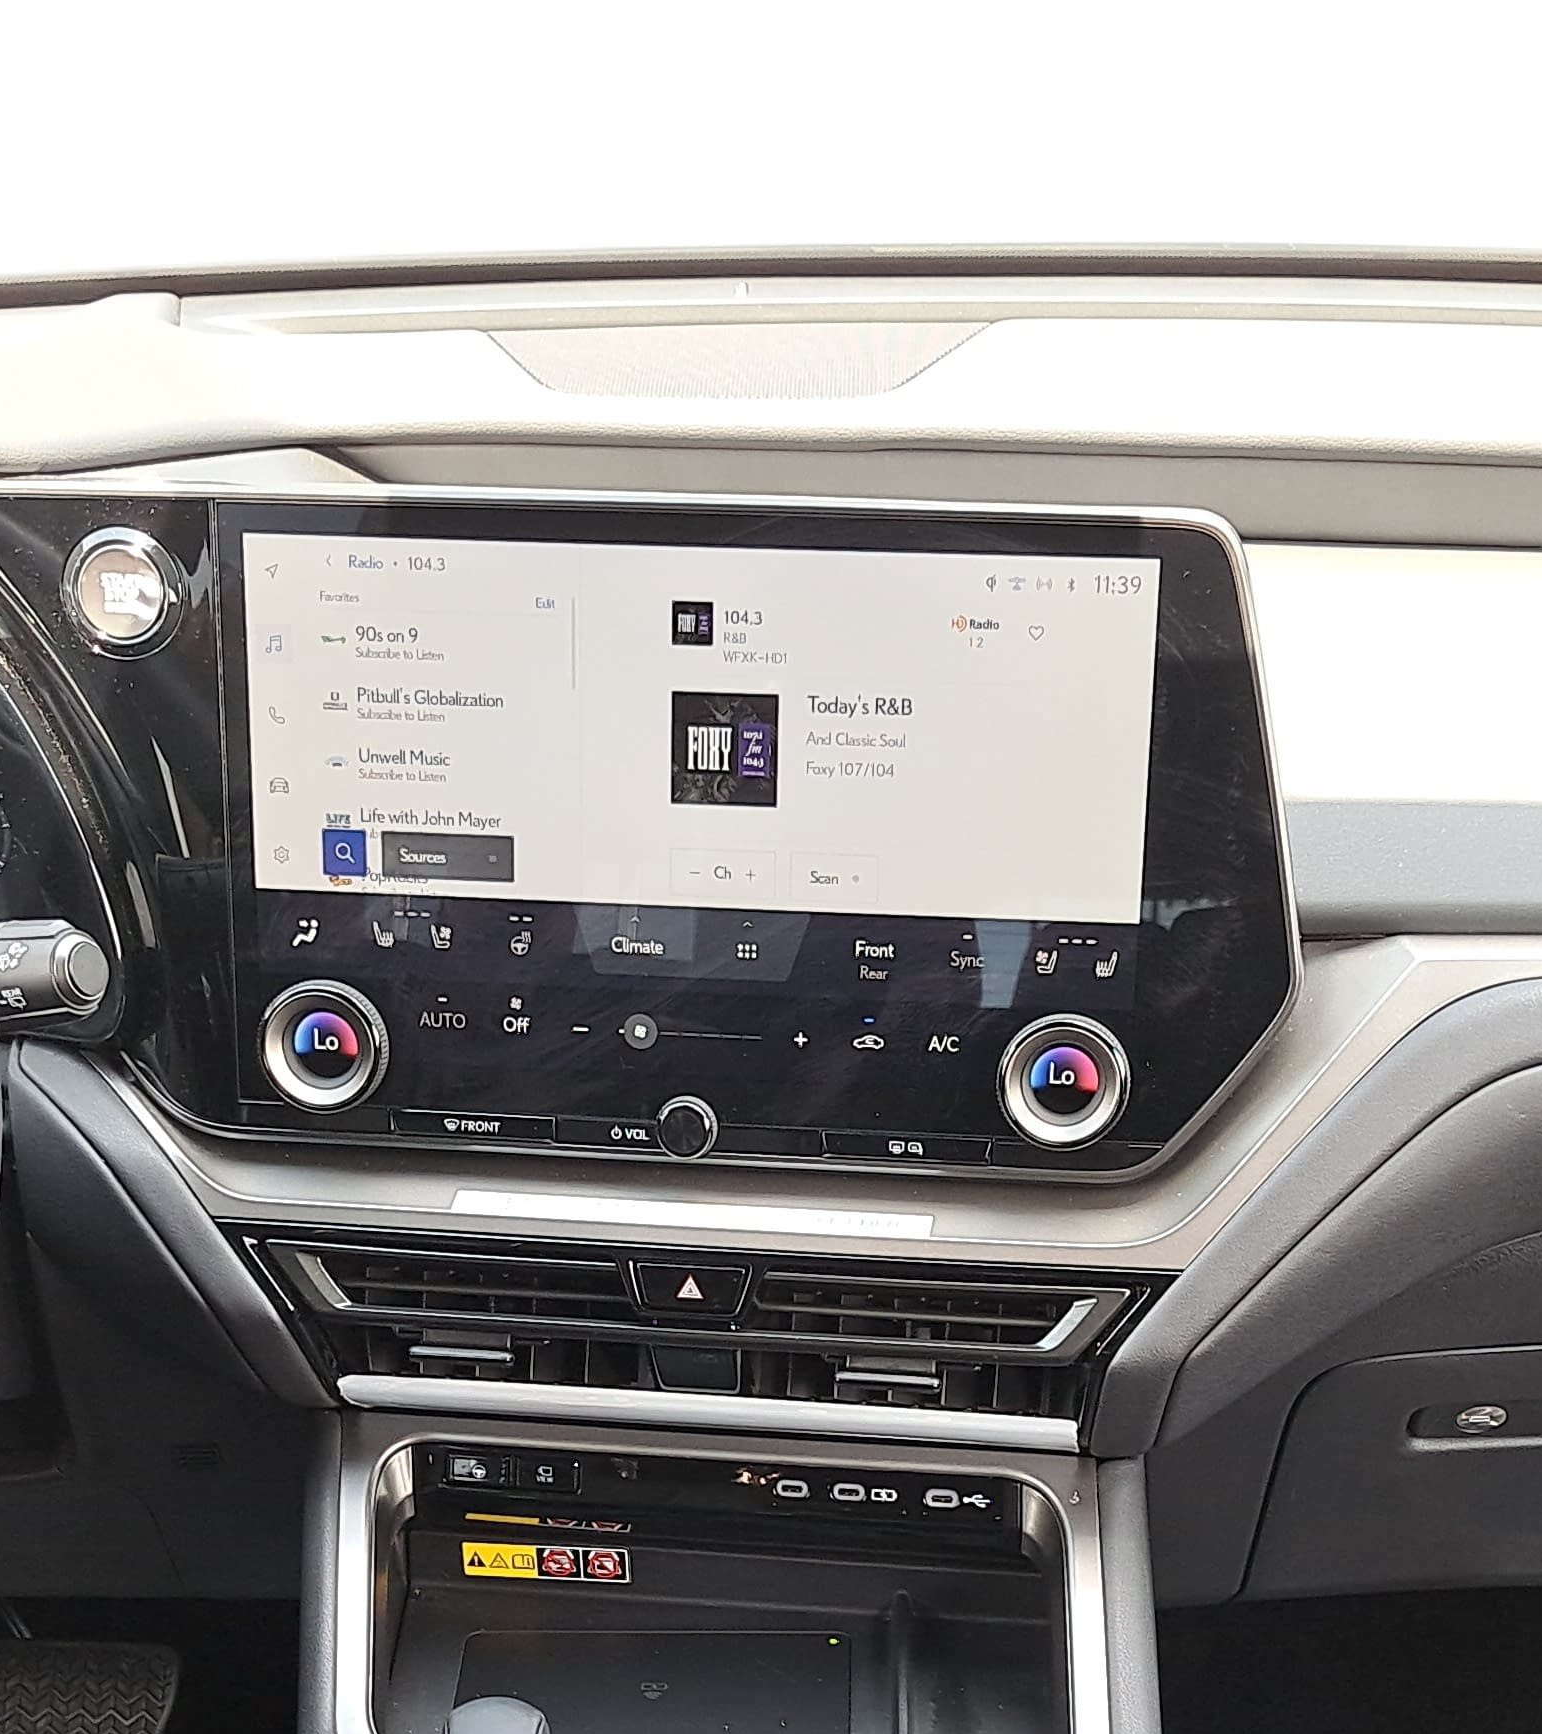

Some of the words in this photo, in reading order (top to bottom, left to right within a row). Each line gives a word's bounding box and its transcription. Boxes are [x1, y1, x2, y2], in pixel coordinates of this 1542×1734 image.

[348, 555, 384, 571] Radio
[407, 556, 446, 571] 104.3
[1093, 574, 1142, 595] 11:39
[319, 591, 360, 604] Favorites
[535, 596, 556, 609] Edit
[723, 610, 763, 626] 104.3
[969, 618, 1000, 630] Radio
[355, 626, 384, 643] 90s
[387, 632, 405, 643] on
[408, 627, 418, 643] 9
[723, 632, 747, 644] R&B
[355, 647, 401, 660] Subscribe
[403, 649, 413, 660] to
[416, 649, 444, 662] Listen
[723, 650, 788, 665] WFXK-HD1
[357, 687, 410, 704] Pitbull's
[414, 689, 504, 708] Globalization
[807, 694, 870, 717] Today's
[874, 697, 913, 717] R&B
[357, 708, 402, 720] Subscribe
[405, 710, 415, 721] to
[417, 710, 445, 722] Listen
[687, 725, 733, 772] FOXY
[806, 732, 832, 747] And
[835, 732, 876, 748] Classic
[878, 732, 906, 749] Soul
[359, 748, 406, 765] Unwell
[410, 750, 451, 766] Music
[359, 768, 404, 781] Subscribe
[406, 771, 416, 781] to
[418, 771, 446, 783] Listen
[806, 761, 836, 779] Foxy
[838, 761, 895, 779] 107/104
[360, 807, 385, 823] Life
[388, 809, 418, 825] with
[421, 809, 454, 827] John
[458, 811, 502, 831] Mayer
[399, 847, 447, 864] Sources
[714, 865, 732, 881] Ch
[809, 871, 839, 886] Scan
[611, 937, 664, 956] Climate
[855, 941, 895, 960] Front
[950, 951, 985, 971] Sync
[859, 966, 889, 982] Rear
[419, 1012, 466, 1029] AUTO
[502, 1016, 531, 1034] Off
[315, 1028, 339, 1051] Lo
[928, 1035, 959, 1053] A/C
[1049, 1062, 1076, 1086] Lo
[461, 1120, 501, 1134] FRONT
[625, 1128, 650, 1141] VOL
